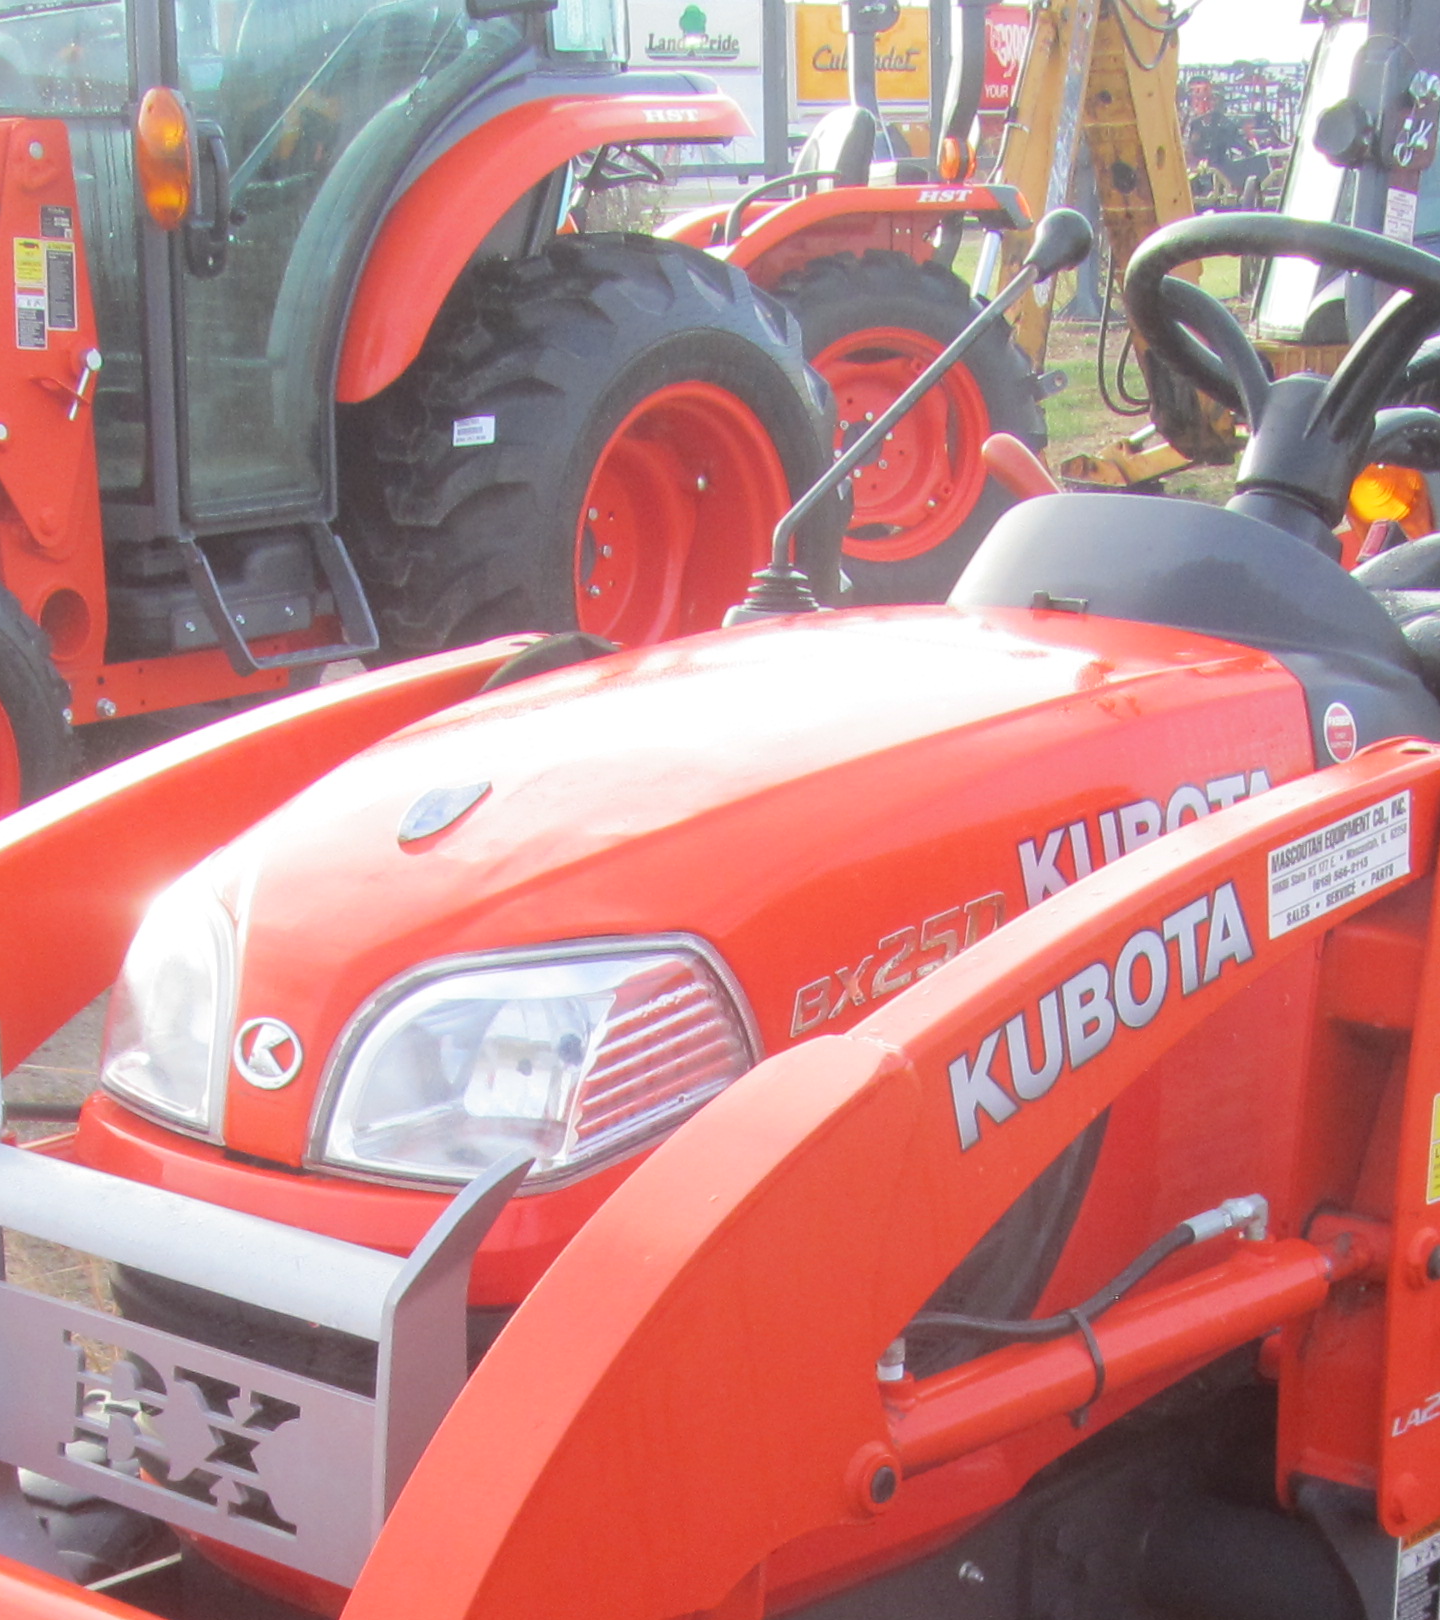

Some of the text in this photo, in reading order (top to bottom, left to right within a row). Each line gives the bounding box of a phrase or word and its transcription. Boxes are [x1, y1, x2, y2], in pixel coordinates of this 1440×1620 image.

[648, 33, 739, 51] Land Pride
[642, 108, 699, 123] HST
[984, 84, 1009, 98] YOUR
[917, 189, 973, 203] HST
[1271, 834, 1323, 874] MASCOUTAH
[1324, 810, 1371, 850] EQUIPMENT
[1286, 862, 1395, 926] SALES SERVICE PARTS
[789, 891, 1006, 1039] BX25D
[948, 879, 1255, 1152] KUBOTA
[57, 1328, 301, 1544] BX
